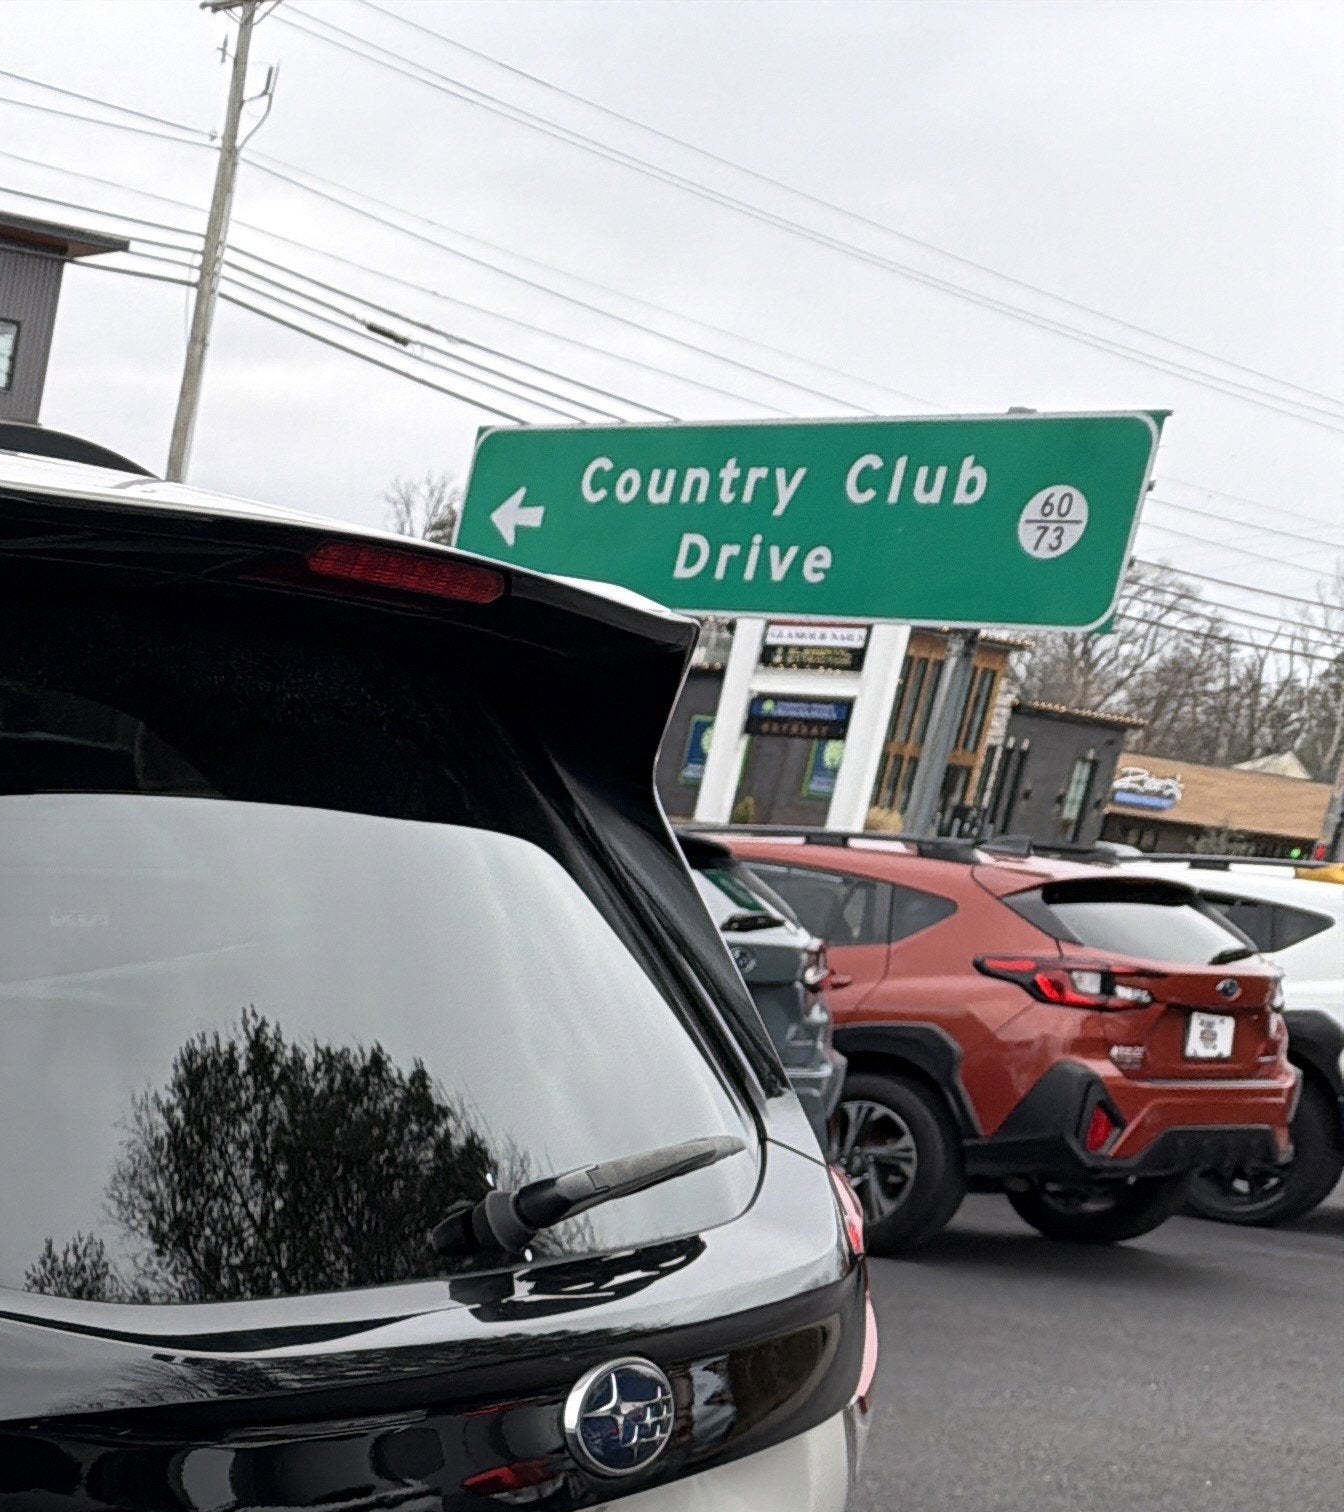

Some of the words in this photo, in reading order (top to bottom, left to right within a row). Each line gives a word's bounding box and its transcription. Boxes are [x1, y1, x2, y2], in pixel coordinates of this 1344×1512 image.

[581, 456, 807, 517] Country
[845, 454, 989, 505] Club
[1039, 491, 1074, 518] 60
[673, 533, 832, 583] Drive
[1031, 525, 1066, 553] 73
